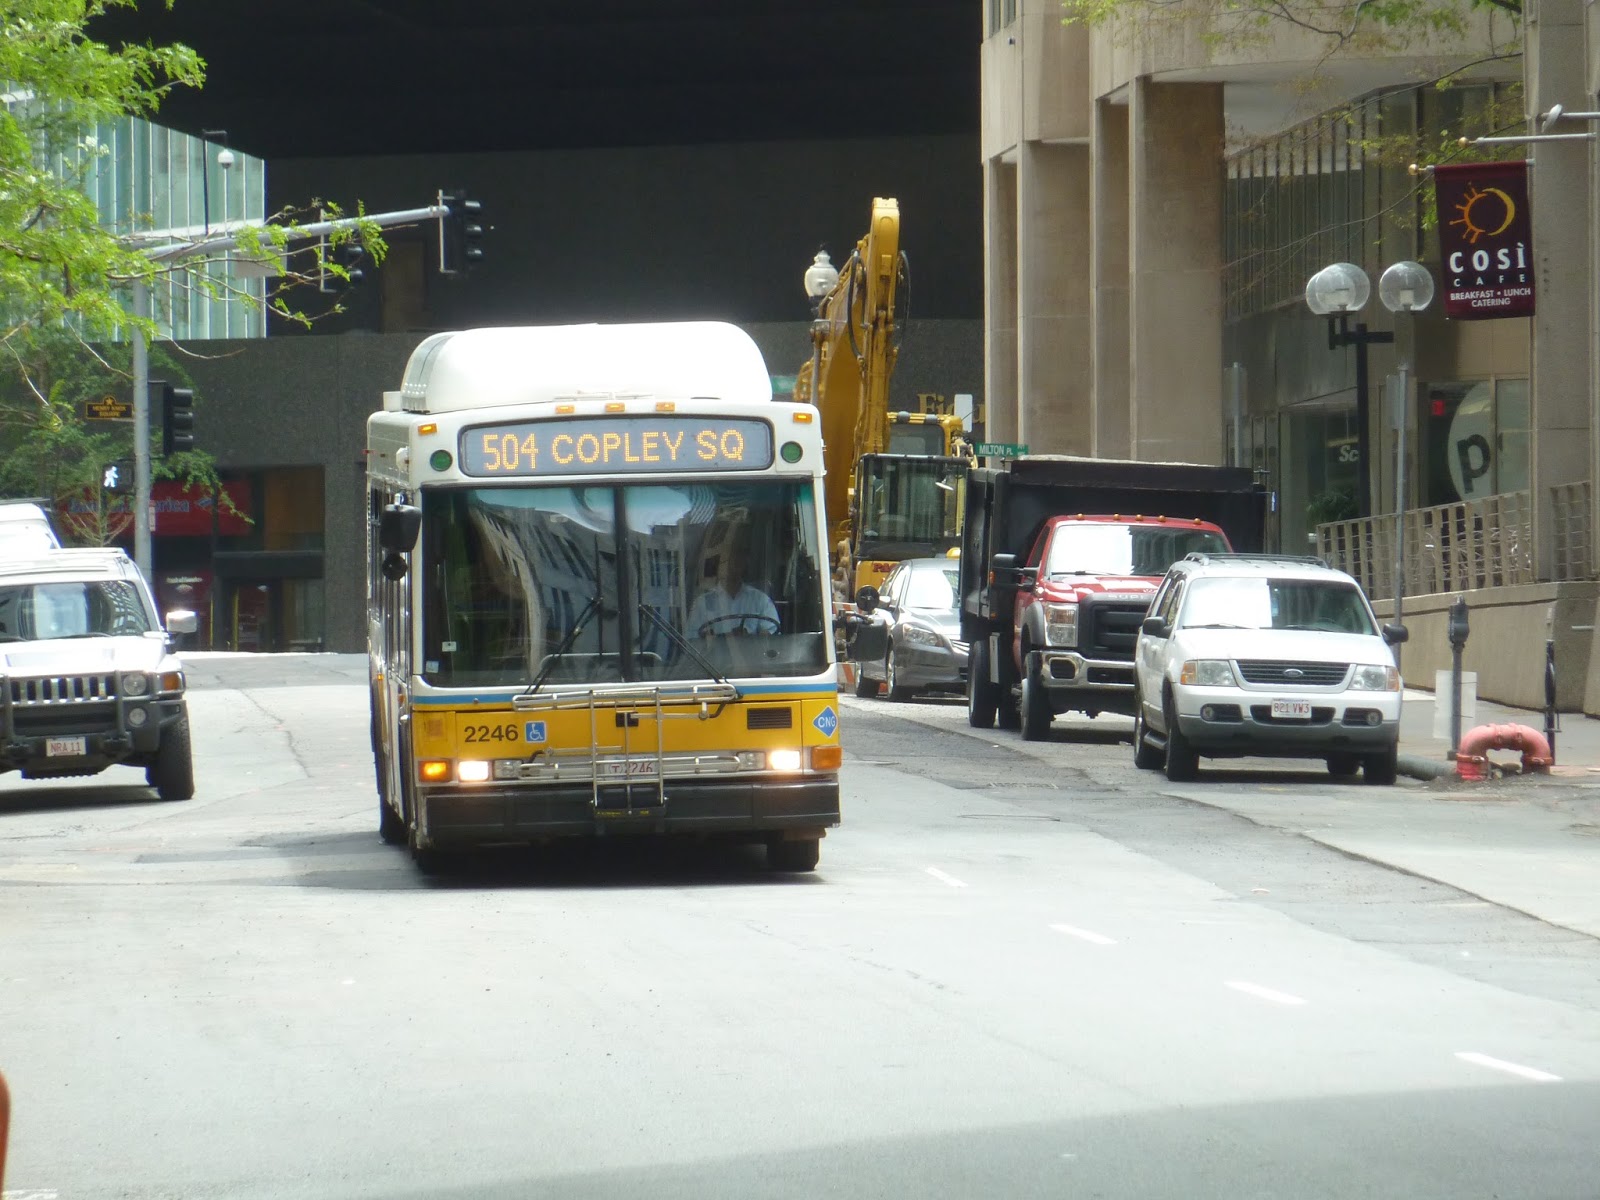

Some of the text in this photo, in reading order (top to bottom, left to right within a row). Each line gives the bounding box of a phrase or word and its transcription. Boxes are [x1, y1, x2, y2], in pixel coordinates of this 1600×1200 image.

[1453, 274, 1526, 287] CAFE
[1450, 287, 1531, 300] BREAKFAST LUNCH
[1471, 297, 1511, 307] CATERING
[483, 429, 745, 470] 504 COPLEY SQ
[979, 444, 1005, 455] MILTON
[1006, 447, 1014, 456] PL
[817, 716, 836, 728] CNG
[464, 723, 519, 743] 2246
[625, 761, 654, 774] 246
